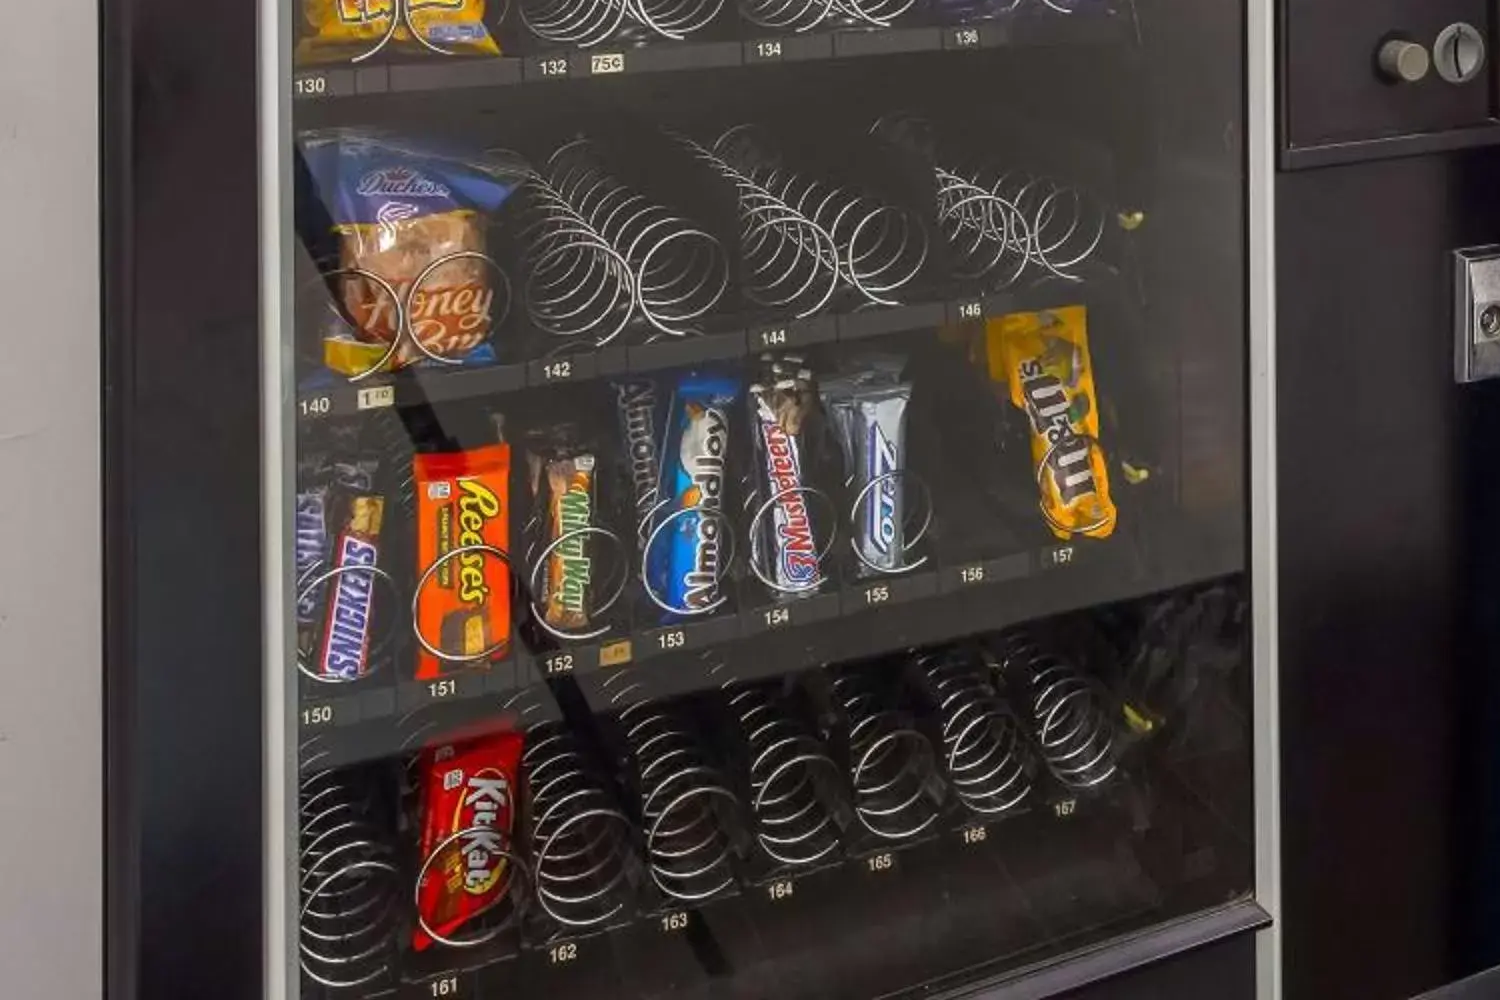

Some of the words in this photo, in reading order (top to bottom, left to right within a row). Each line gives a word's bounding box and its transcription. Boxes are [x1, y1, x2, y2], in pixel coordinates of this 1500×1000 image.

[955, 30, 979, 45] 136
[757, 42, 782, 57] 134
[540, 59, 568, 75] 132
[295, 77, 326, 94] 130
[959, 304, 982, 318] 146
[761, 330, 787, 346] 144
[543, 362, 572, 379] 142
[300, 397, 331, 415] 140
[695, 406, 728, 478] Joy
[760, 420, 817, 554] Musketeers
[453, 477, 500, 605] Reese's
[683, 474, 725, 612] Almond
[1052, 548, 1073, 563] 157
[783, 551, 821, 583] 3
[961, 568, 983, 583] 156
[560, 555, 592, 612] Way
[865, 586, 889, 603] 155
[327, 536, 375, 682] SNICKERS
[764, 609, 789, 626] 154
[658, 632, 686, 649] 153
[545, 655, 574, 673] 152
[428, 681, 456, 698] 151
[302, 706, 332, 725] 150
[1054, 799, 1077, 818] 167
[963, 826, 987, 845] 166
[868, 854, 892, 872] 165
[768, 880, 794, 901] 164
[661, 913, 689, 931] 163
[549, 944, 578, 964] 162
[431, 978, 459, 998] 161
